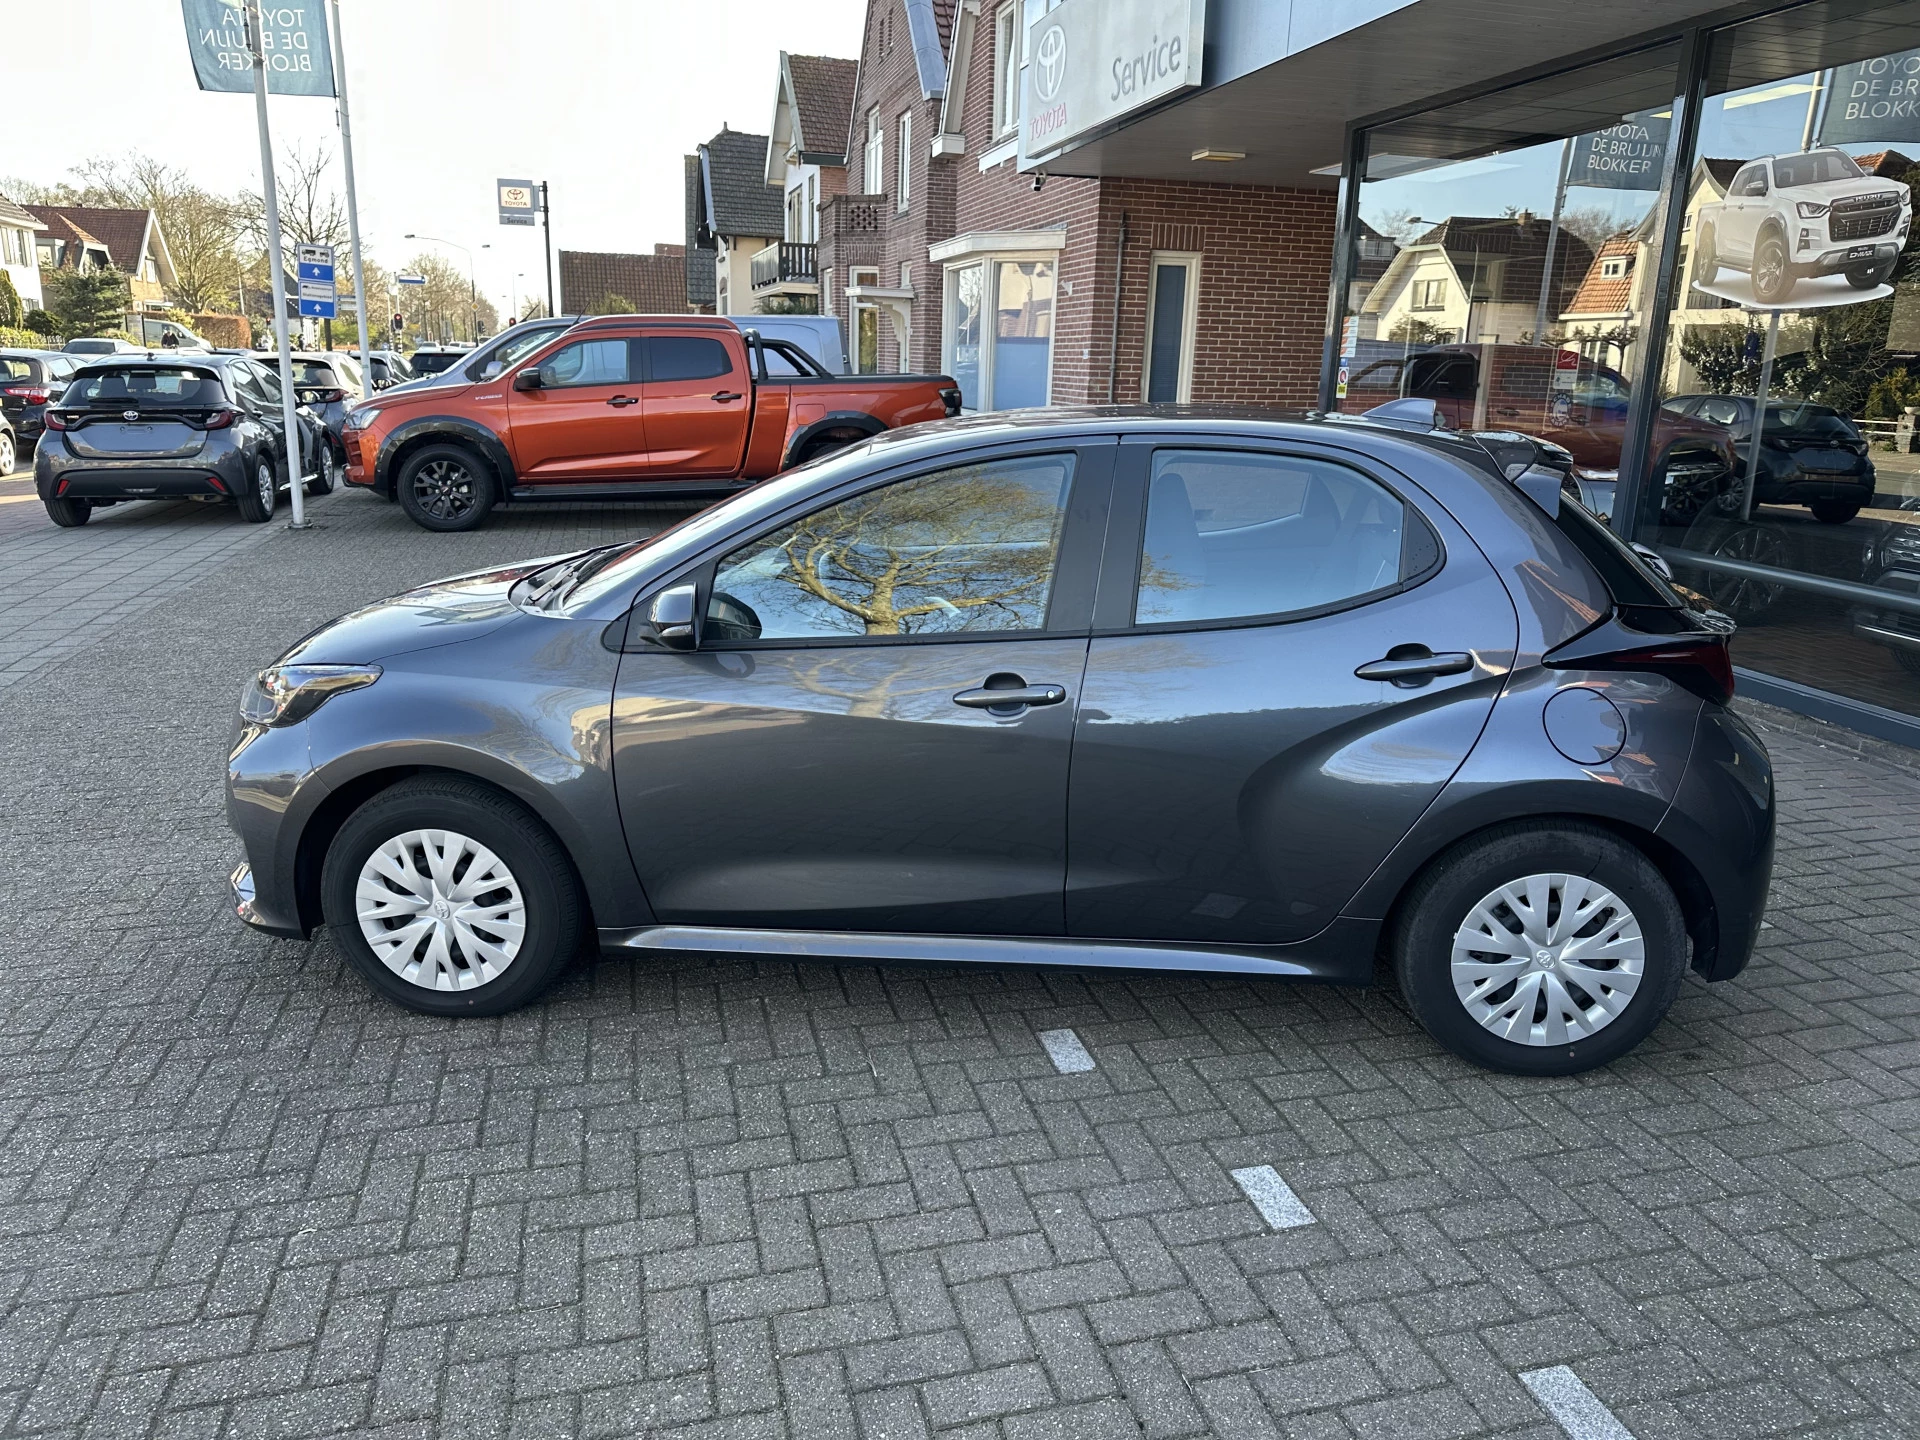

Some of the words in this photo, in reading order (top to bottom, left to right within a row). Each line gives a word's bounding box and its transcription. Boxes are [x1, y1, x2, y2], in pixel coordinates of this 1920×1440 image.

[1111, 34, 1182, 102] Service
[1850, 80, 1883, 98] DE
[1845, 101, 1920, 120] BLOKK
[1030, 102, 1067, 142] TOYOTA
[1596, 124, 1649, 140] OYOTA
[1591, 138, 1608, 153] DE
[1587, 154, 1652, 173] BLOKKER
[303, 256, 329, 264] Egmond
